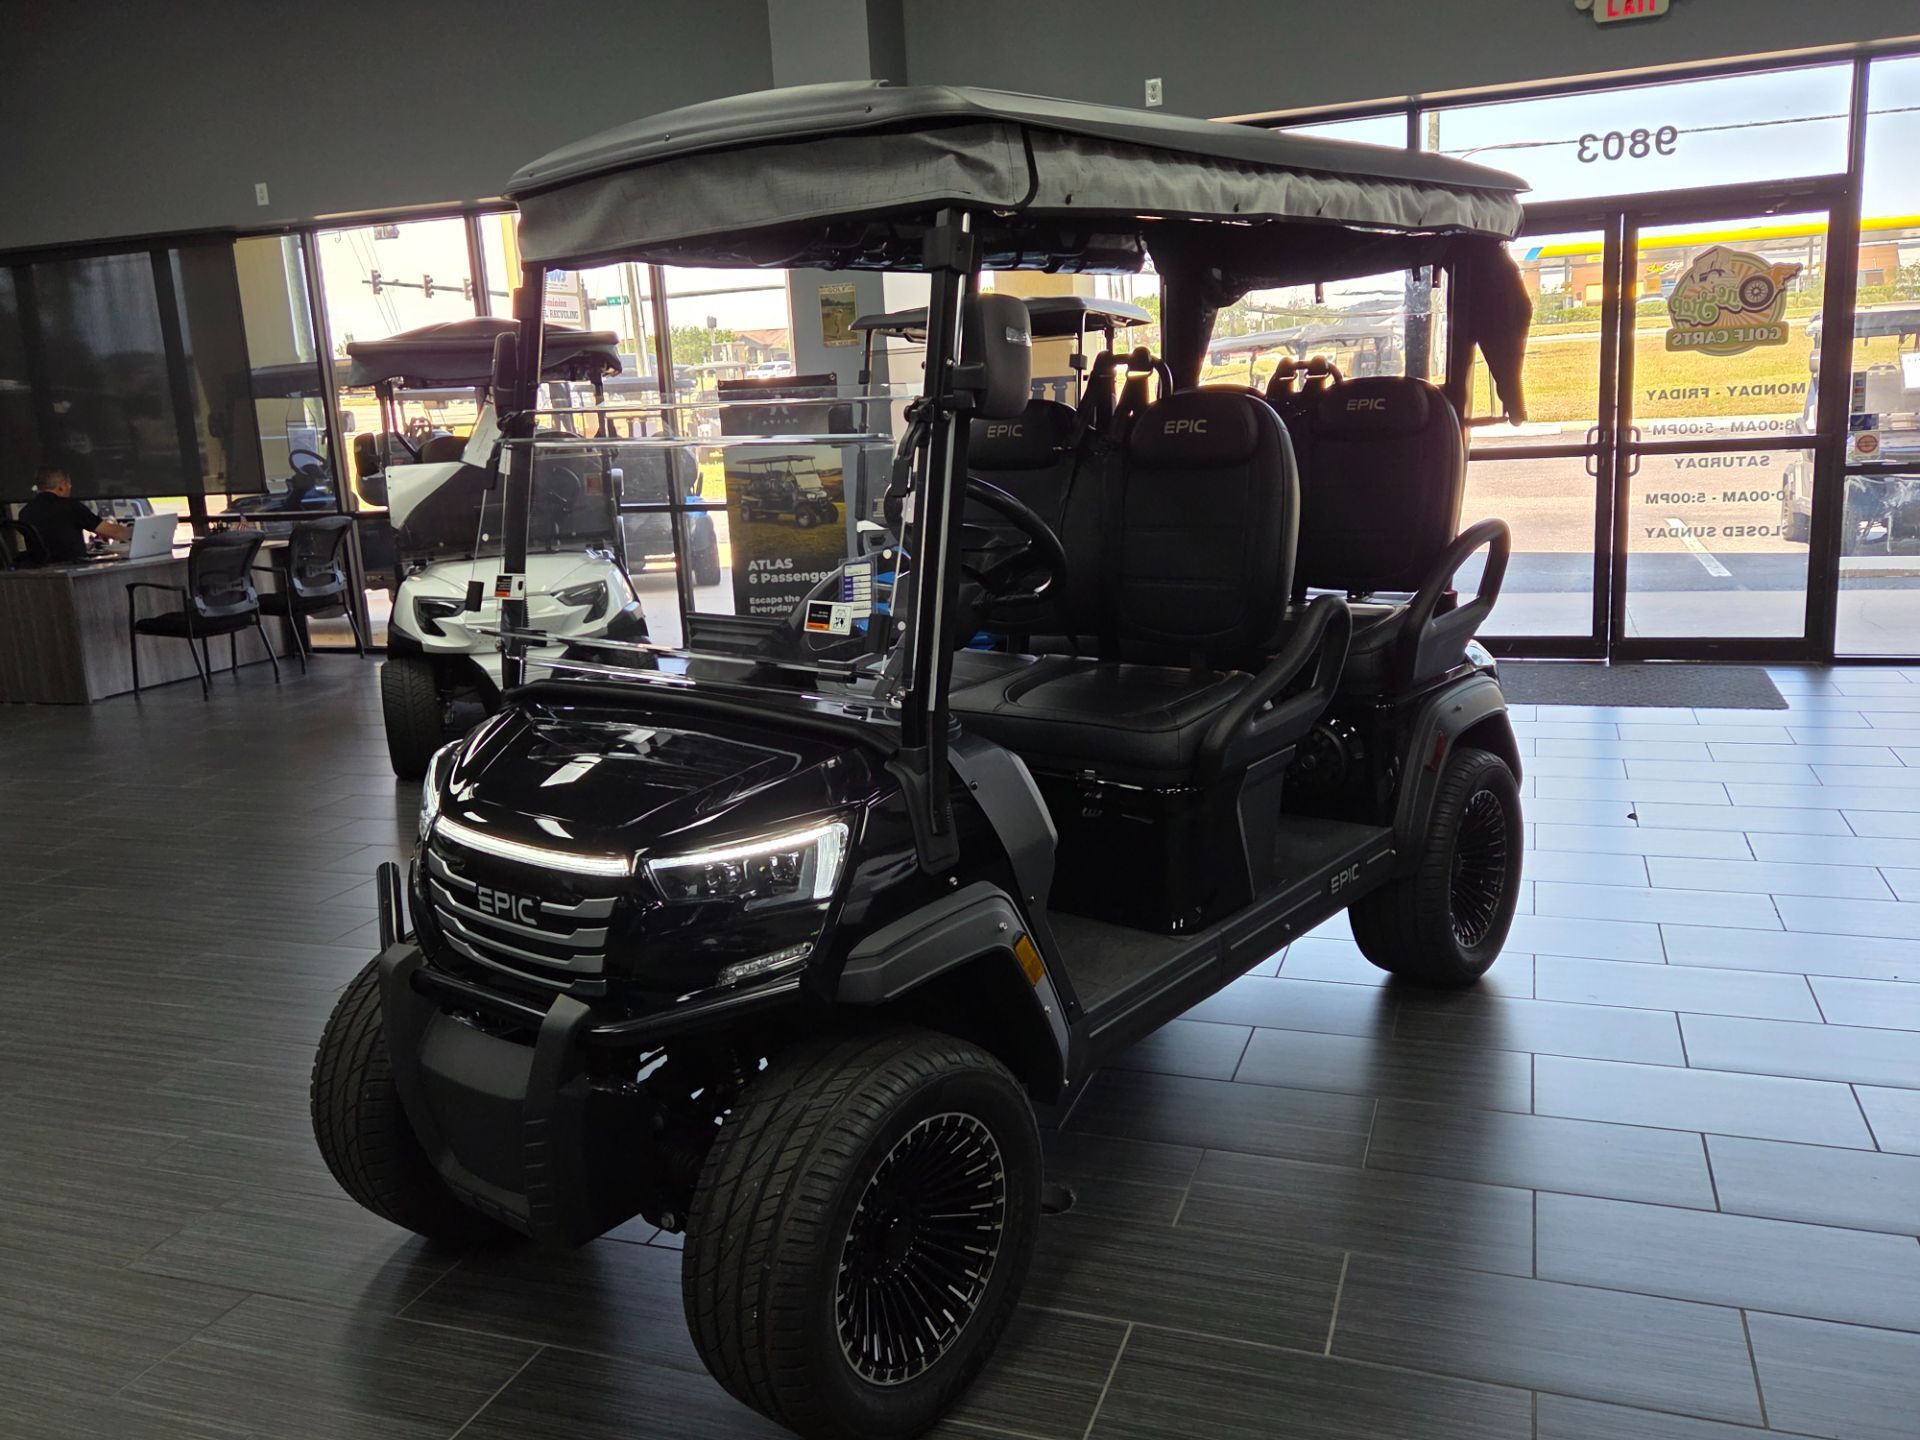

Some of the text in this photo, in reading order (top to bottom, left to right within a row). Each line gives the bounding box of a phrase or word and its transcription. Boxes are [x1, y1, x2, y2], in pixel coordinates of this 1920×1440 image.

[1346, 398, 1386, 411] EPIC
[986, 424, 1023, 438] EPIC
[1163, 419, 1207, 434] EPIC
[748, 558, 794, 571] ATLAS
[749, 573, 758, 584] 6
[749, 594, 801, 605] Escape the
[750, 605, 794, 615] Everyday
[1330, 863, 1360, 895] EPIC
[477, 885, 538, 926] EPIC
